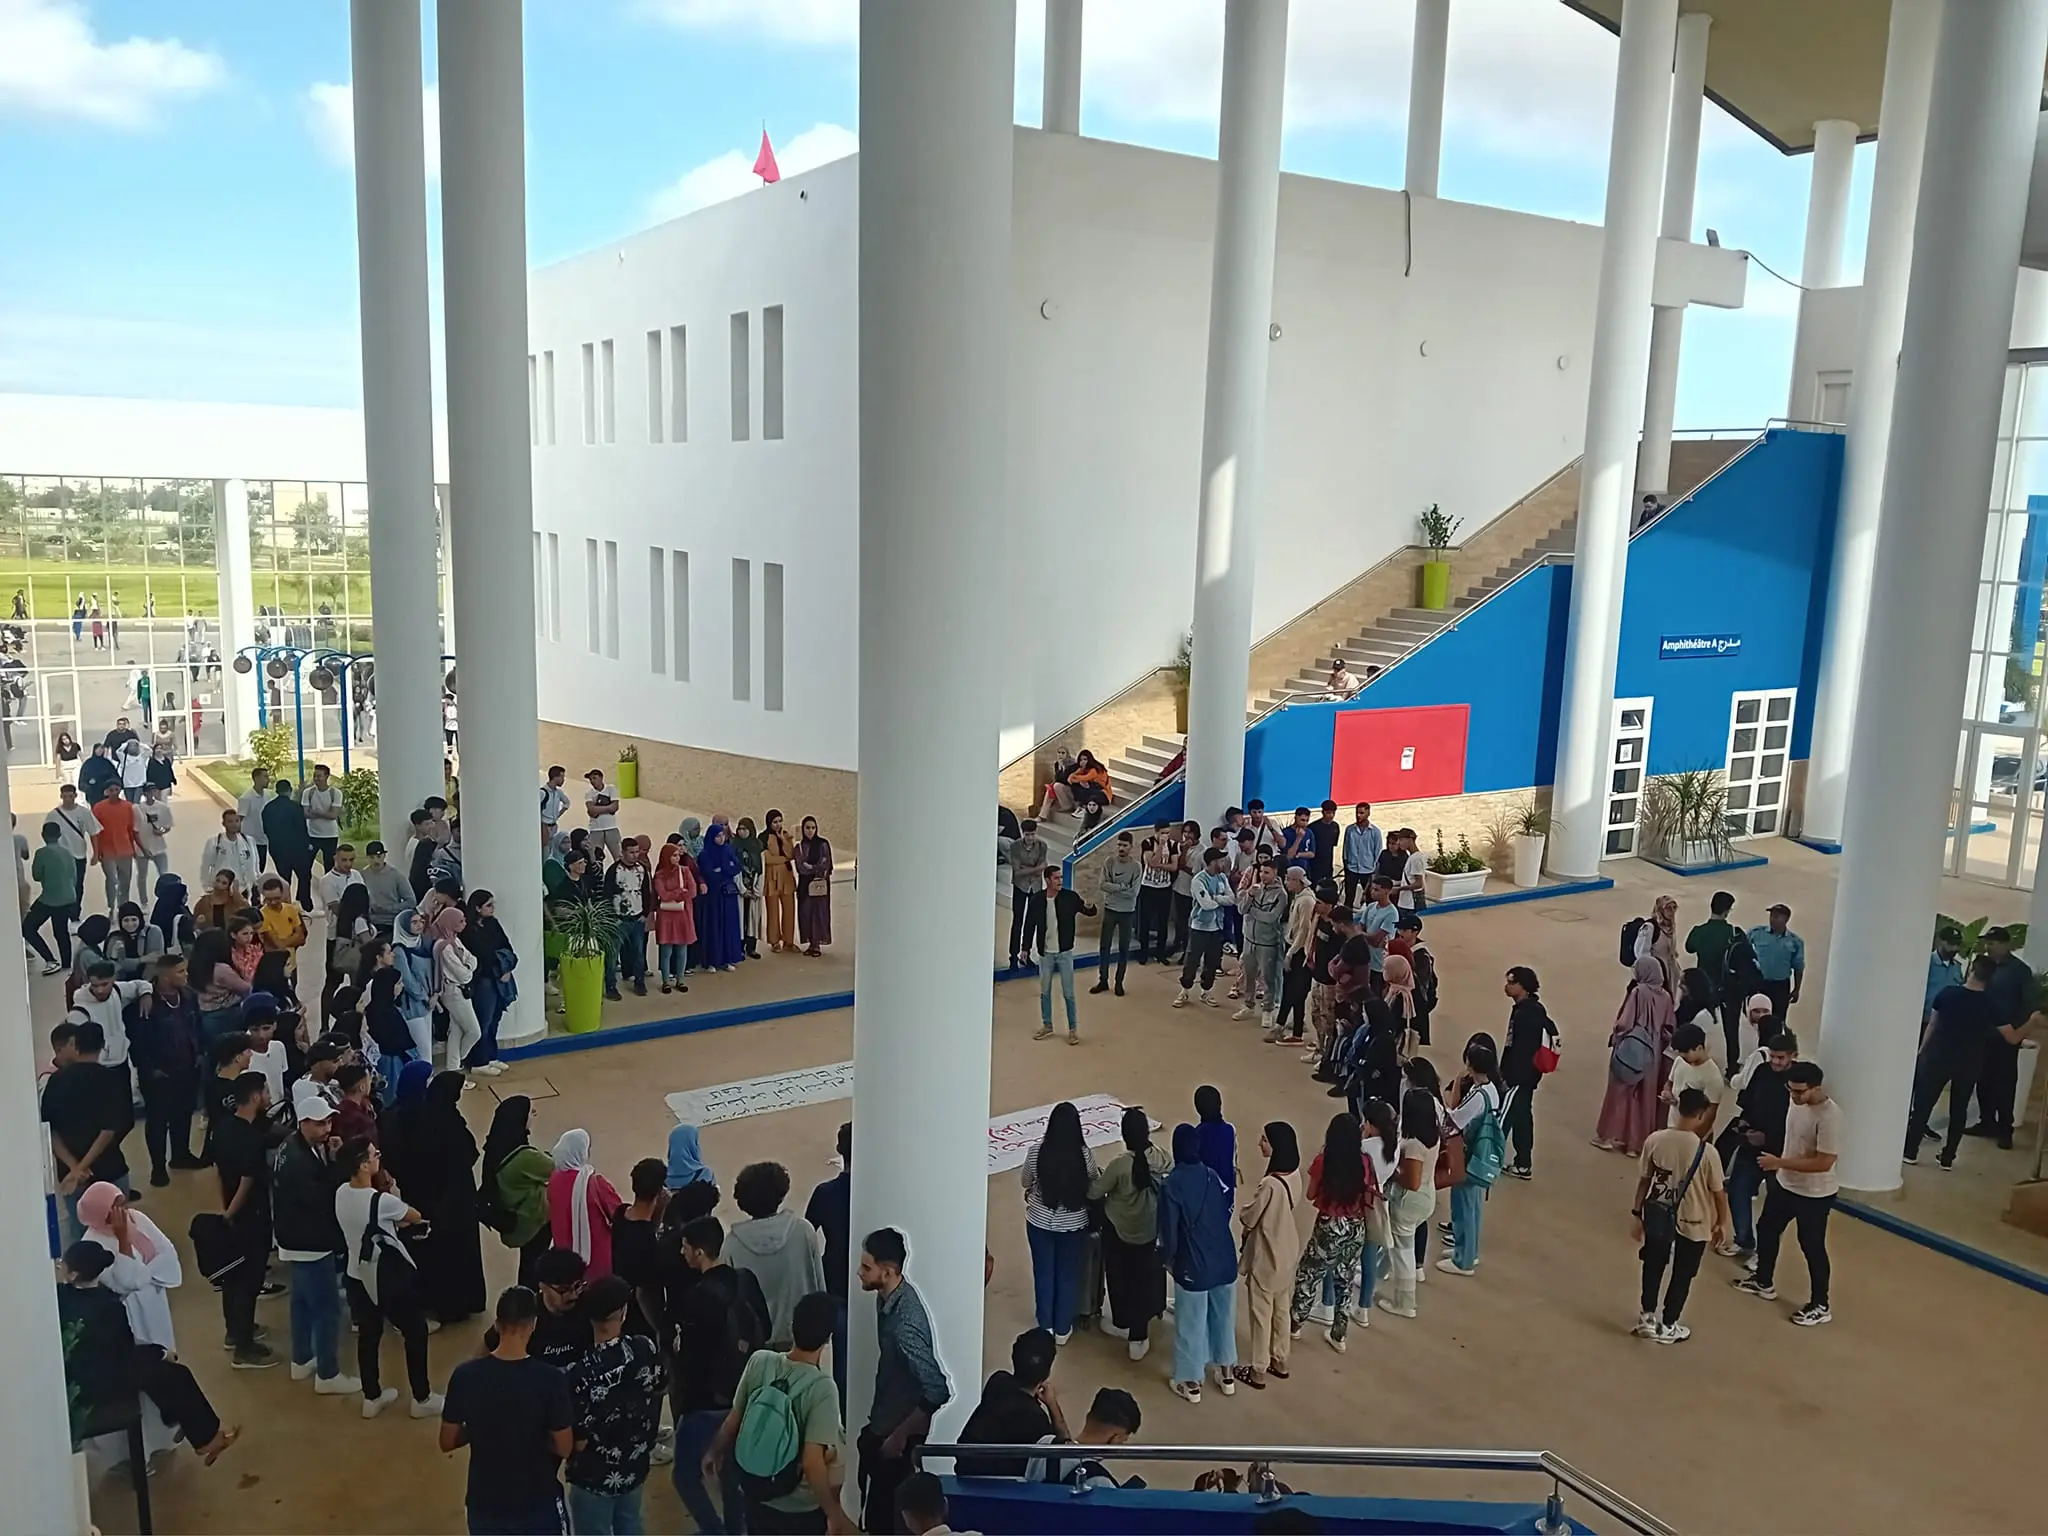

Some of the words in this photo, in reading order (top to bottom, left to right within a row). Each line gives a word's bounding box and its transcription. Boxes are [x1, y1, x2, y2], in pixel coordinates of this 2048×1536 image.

[1662, 638, 1711, 652] Amphithéâtre
[1711, 638, 1717, 648] A
[1717, 638, 1741, 653] مدرج
